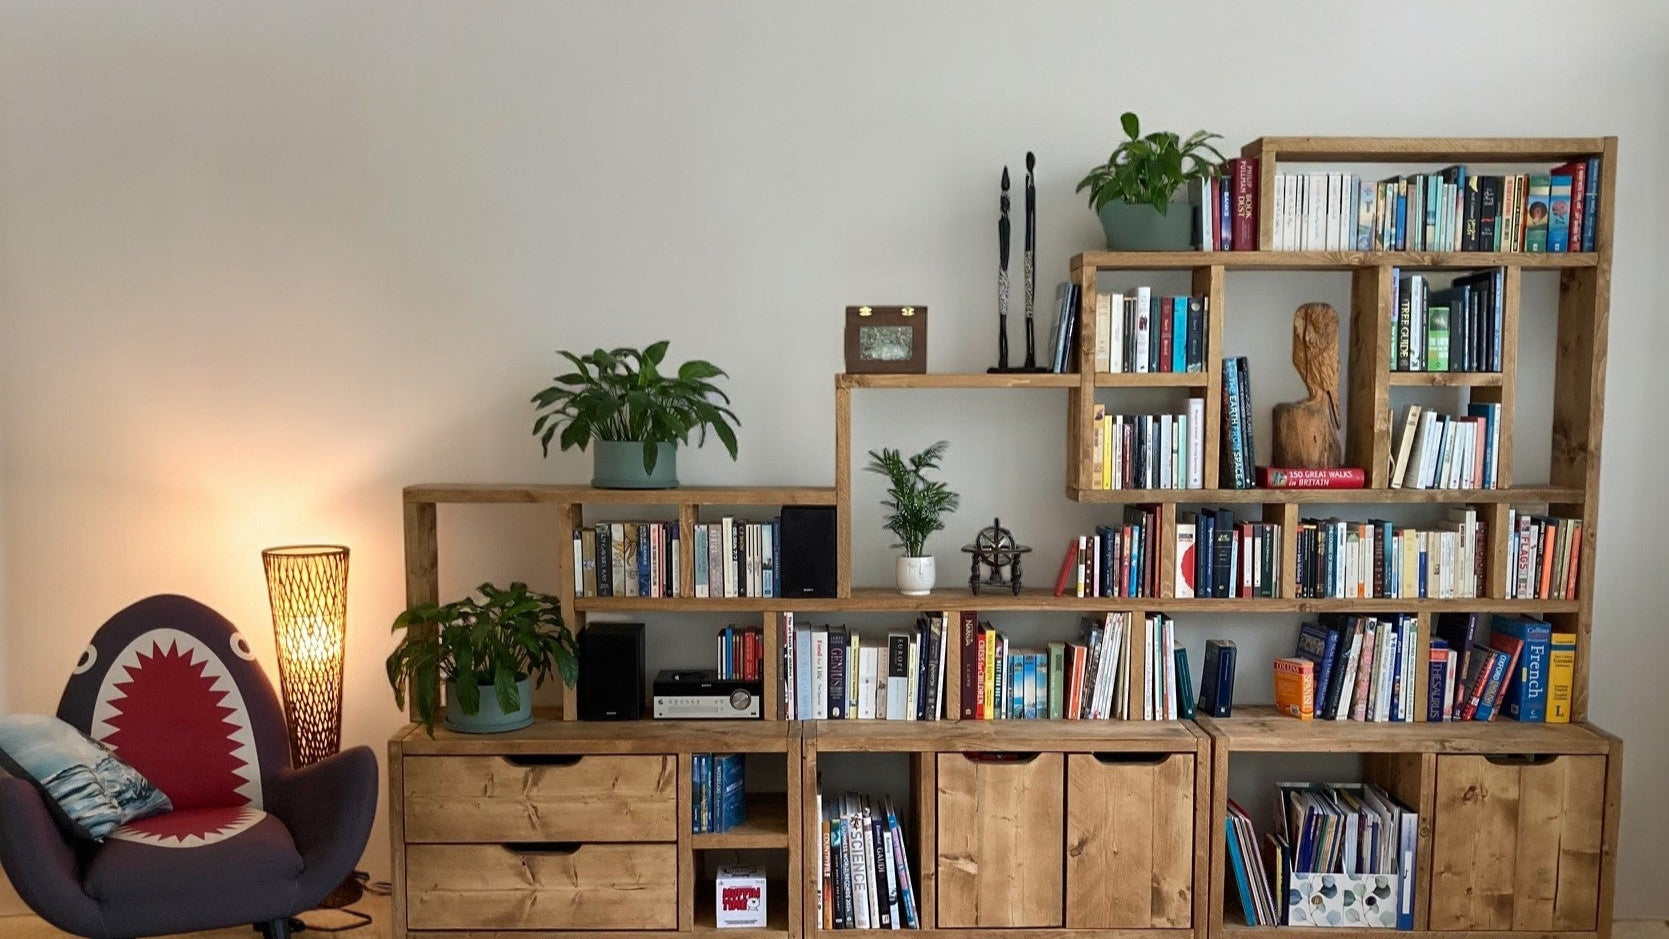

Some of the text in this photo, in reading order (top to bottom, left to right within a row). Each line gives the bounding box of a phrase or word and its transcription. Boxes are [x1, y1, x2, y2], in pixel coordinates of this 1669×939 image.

[1400, 301, 1410, 358] TREE GUIDE
[1229, 395, 1240, 425] EARTH
[1232, 425, 1241, 450] FROM
[1233, 452, 1243, 479] SPACE
[1289, 470, 1304, 478] 150
[1304, 470, 1326, 478] GREAT
[1519, 536, 1530, 570] FLAGS
[965, 619, 974, 647] NARNIA
[816, 666, 824, 680] Life
[830, 647, 843, 687] GENIUS
[1276, 662, 1299, 673] COLLINS
[1492, 654, 1507, 681] OXFORD
[1528, 644, 1545, 699] French
[1303, 674, 1313, 707] SPANISH
[1430, 663, 1443, 719] THESAURUS
[1556, 705, 1564, 717] L
[841, 825, 849, 853] GUINNESS
[823, 832, 831, 878] COUNTRYFILE
[850, 831, 866, 891] SCIENCE
[876, 847, 885, 873] GAUDI
[843, 873, 851, 898] RECORDS
[722, 898, 748, 911] TIME
